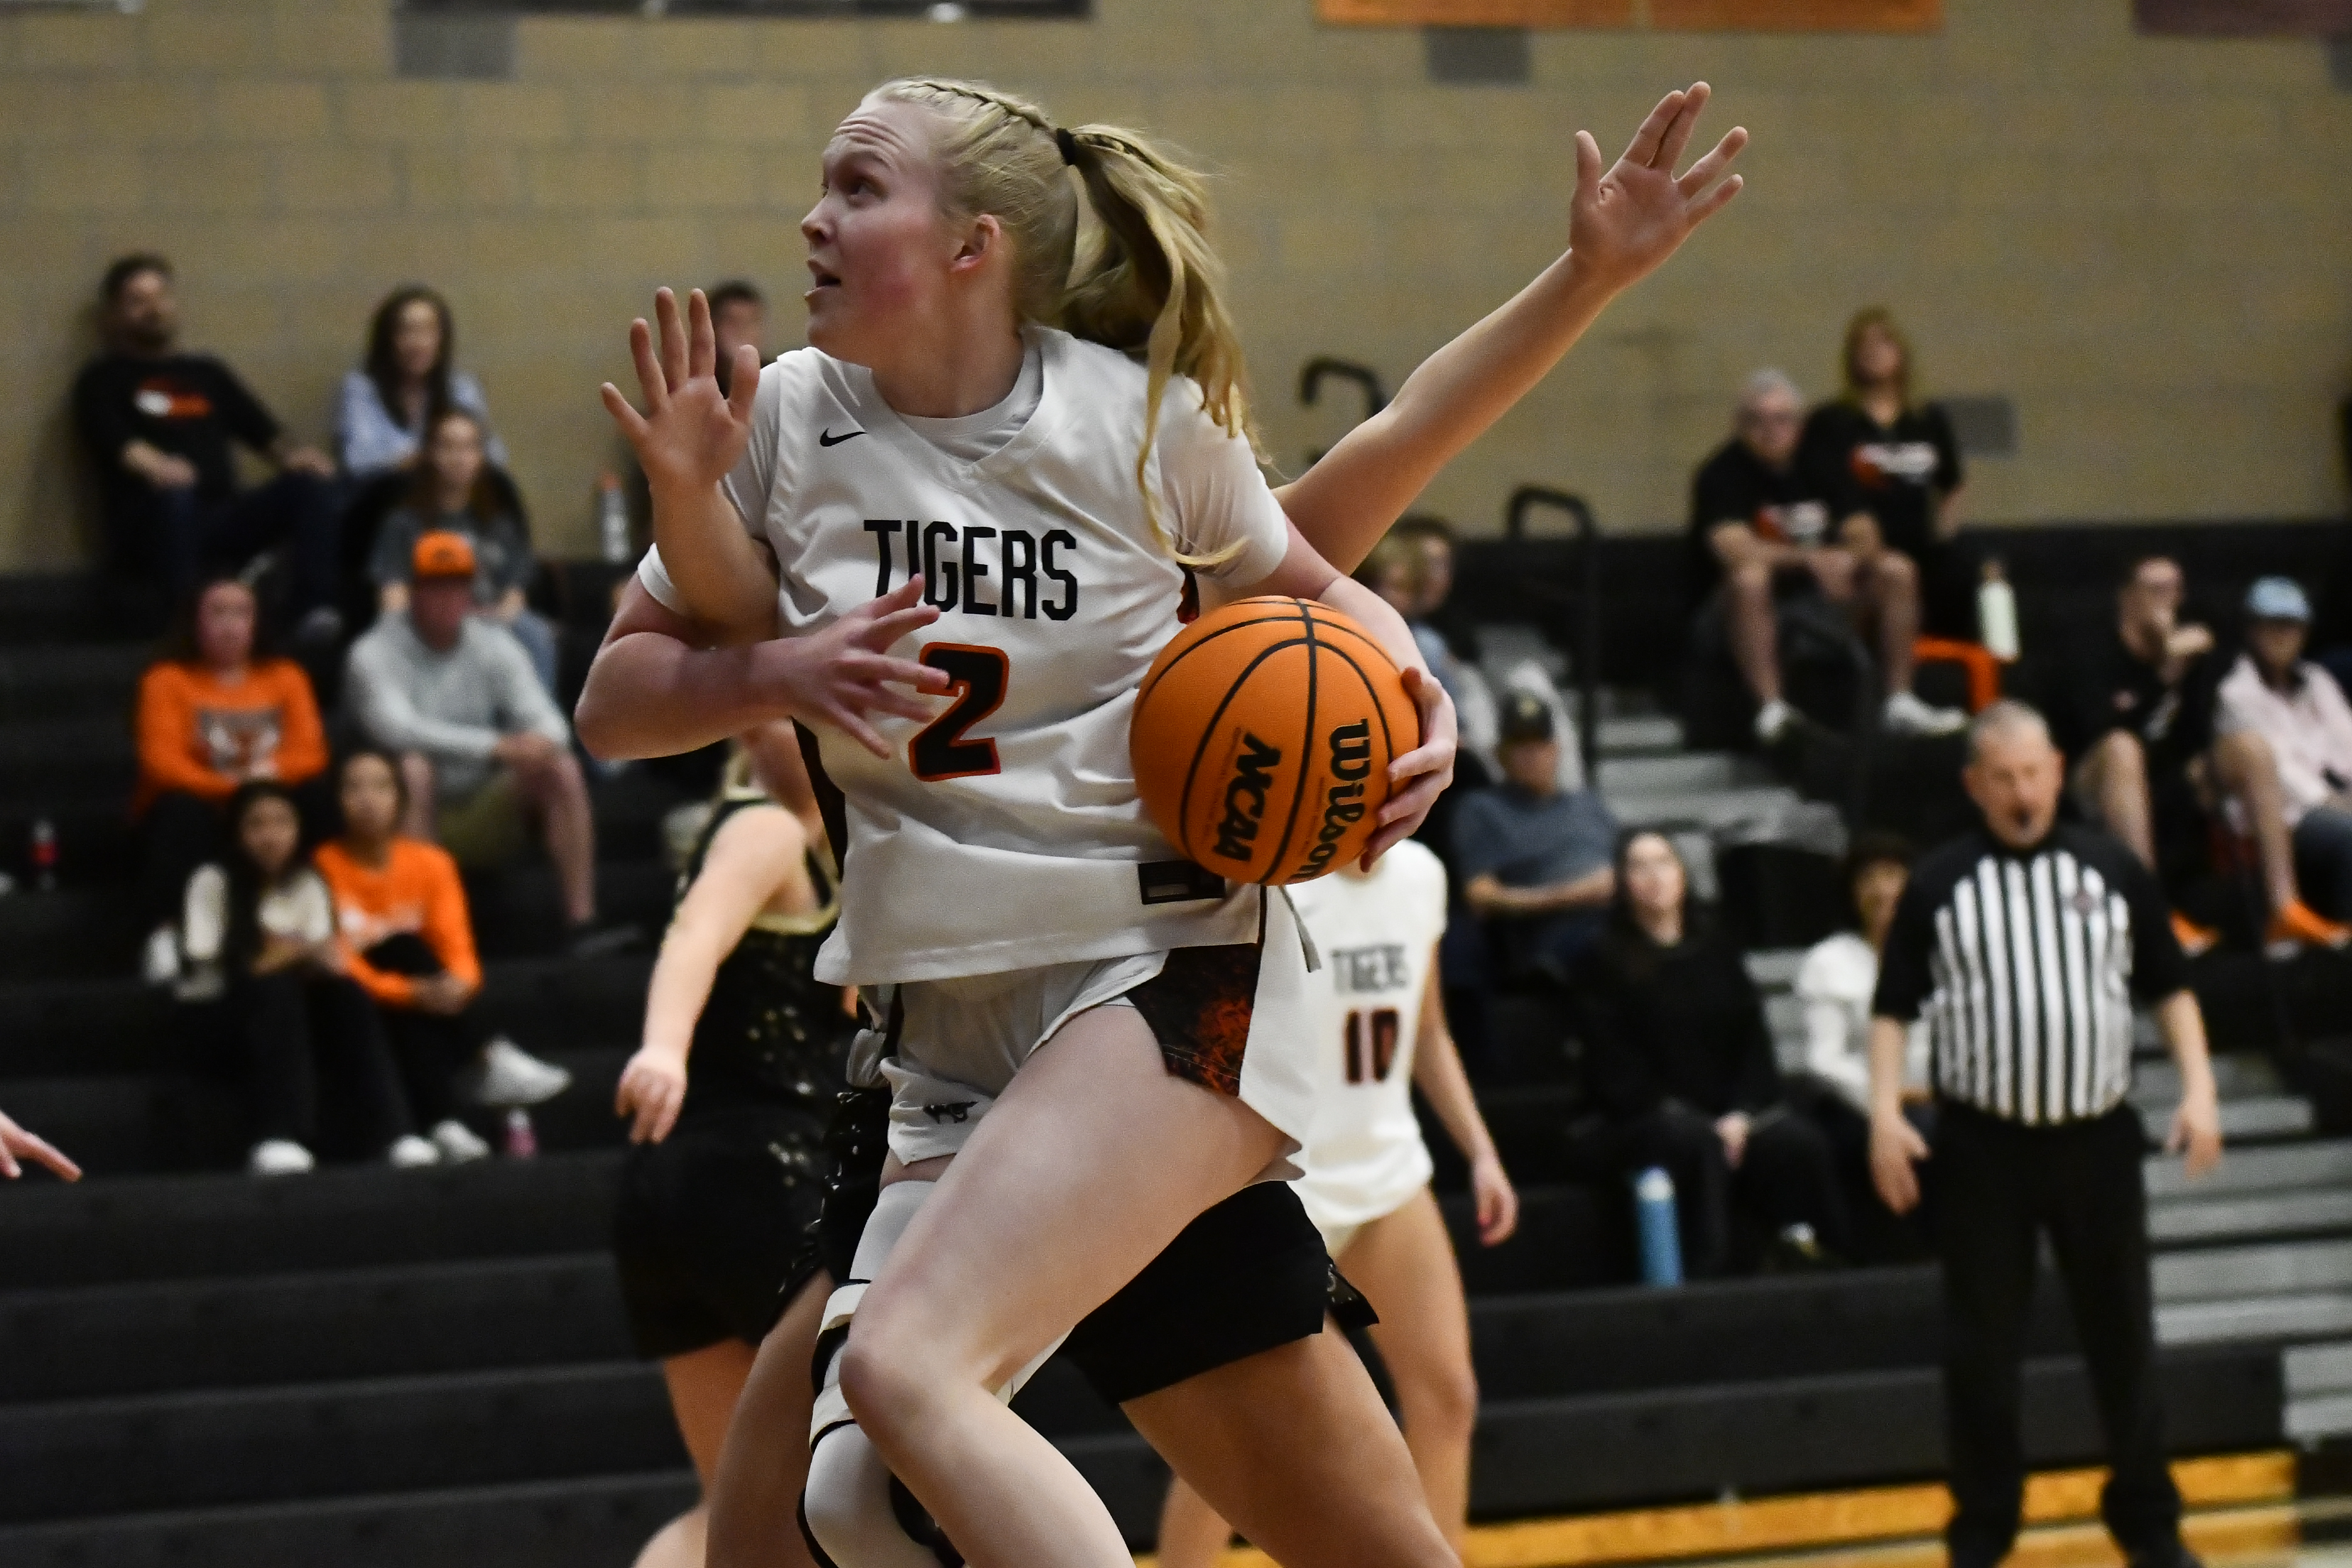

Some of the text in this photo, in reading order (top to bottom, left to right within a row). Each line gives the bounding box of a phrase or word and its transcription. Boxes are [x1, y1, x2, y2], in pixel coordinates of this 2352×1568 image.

[864, 520, 1078, 621] TIGERS
[908, 642, 1010, 782] 2
[1213, 732, 1282, 862] NCAA
[1289, 718, 1370, 879] Wilson
[1344, 1006, 1402, 1085] 10
